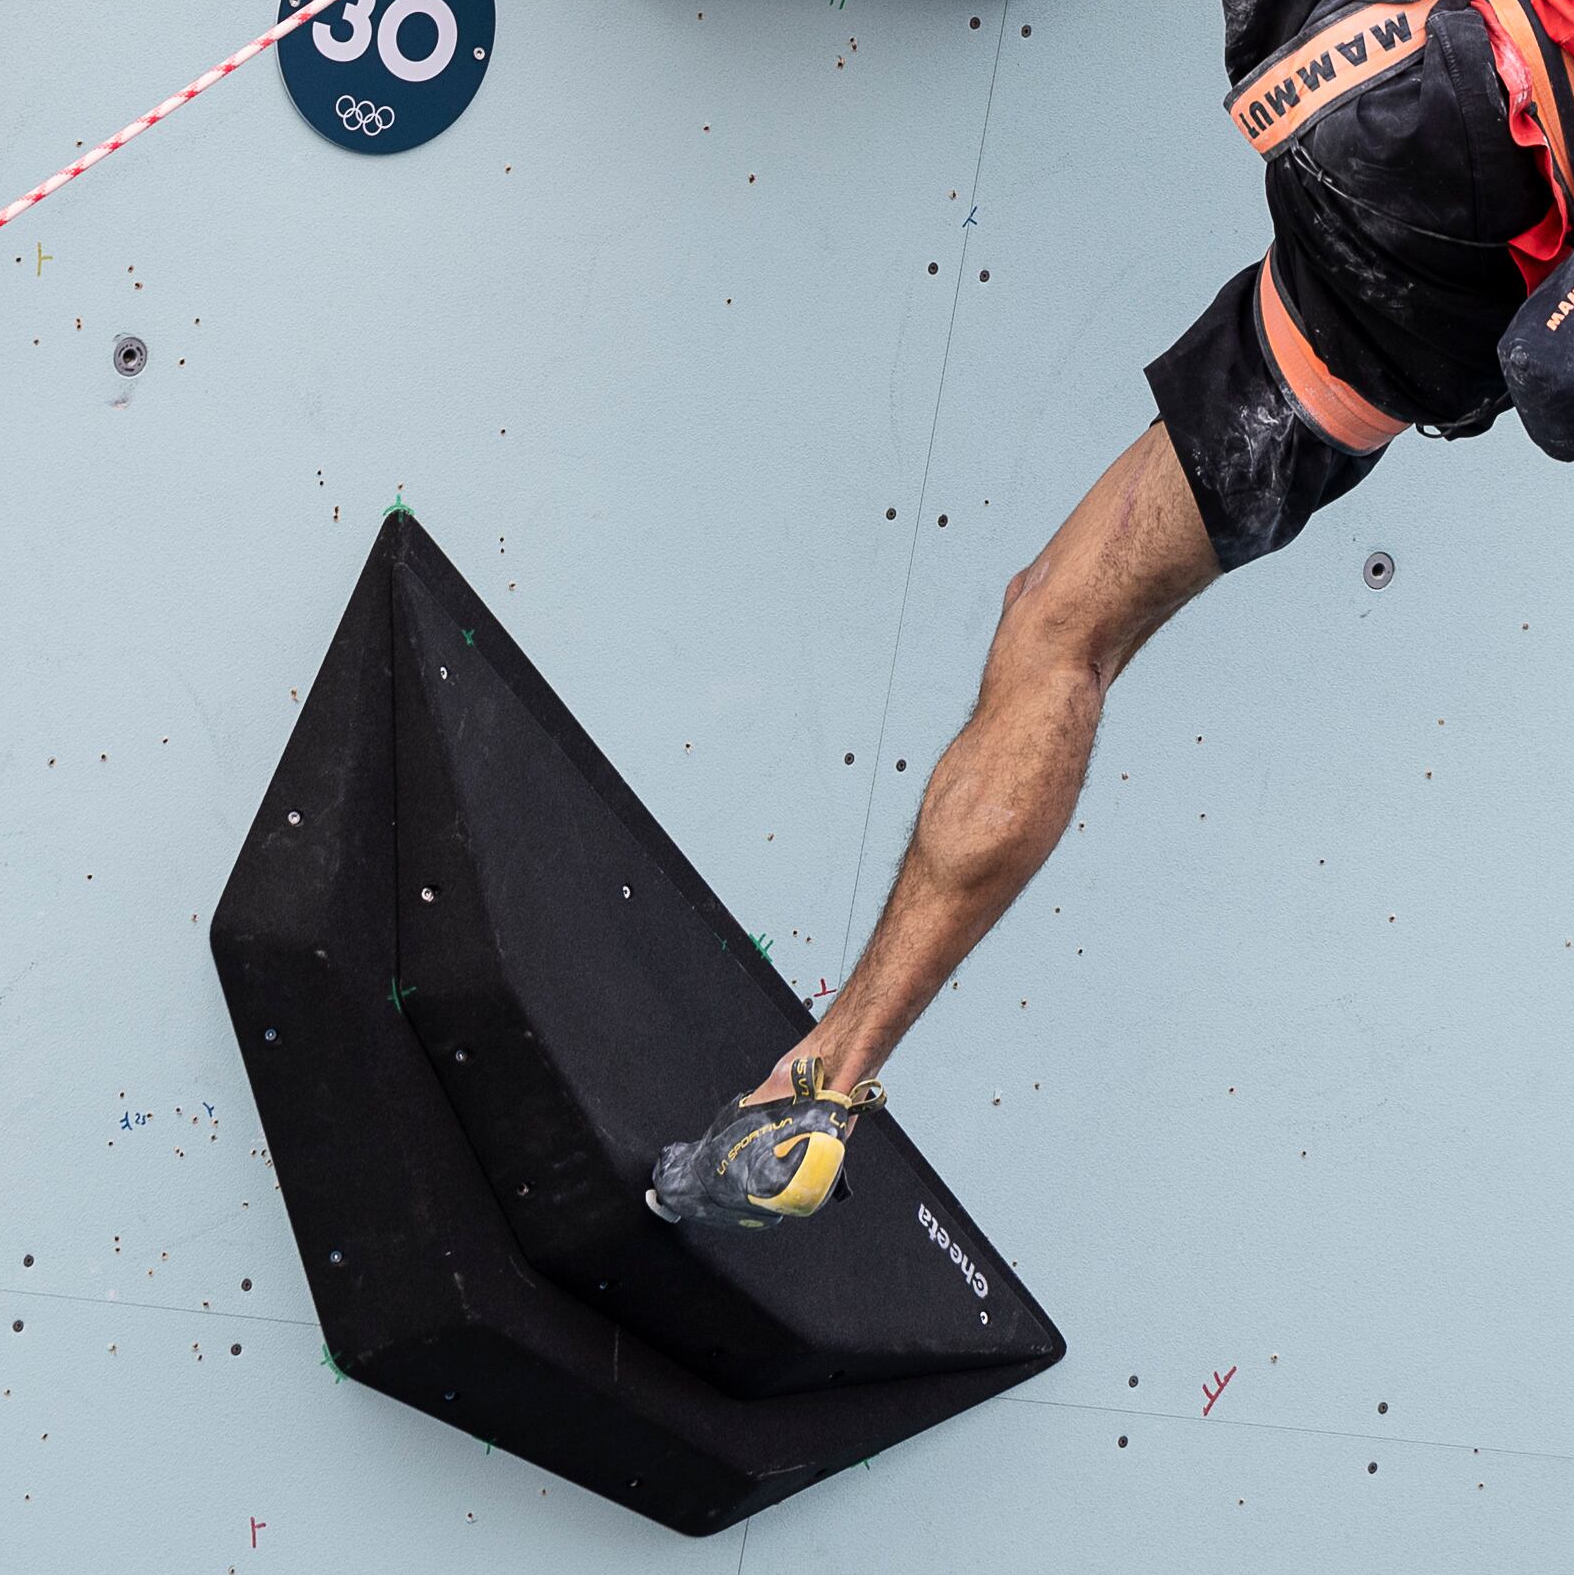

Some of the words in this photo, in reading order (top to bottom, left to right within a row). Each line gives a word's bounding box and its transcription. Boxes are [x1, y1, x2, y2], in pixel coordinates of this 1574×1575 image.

[1238, 11, 1412, 139] MAMMUT
[728, 1117, 793, 1161] SPORTIVA
[918, 1203, 989, 1299] Cheeta
